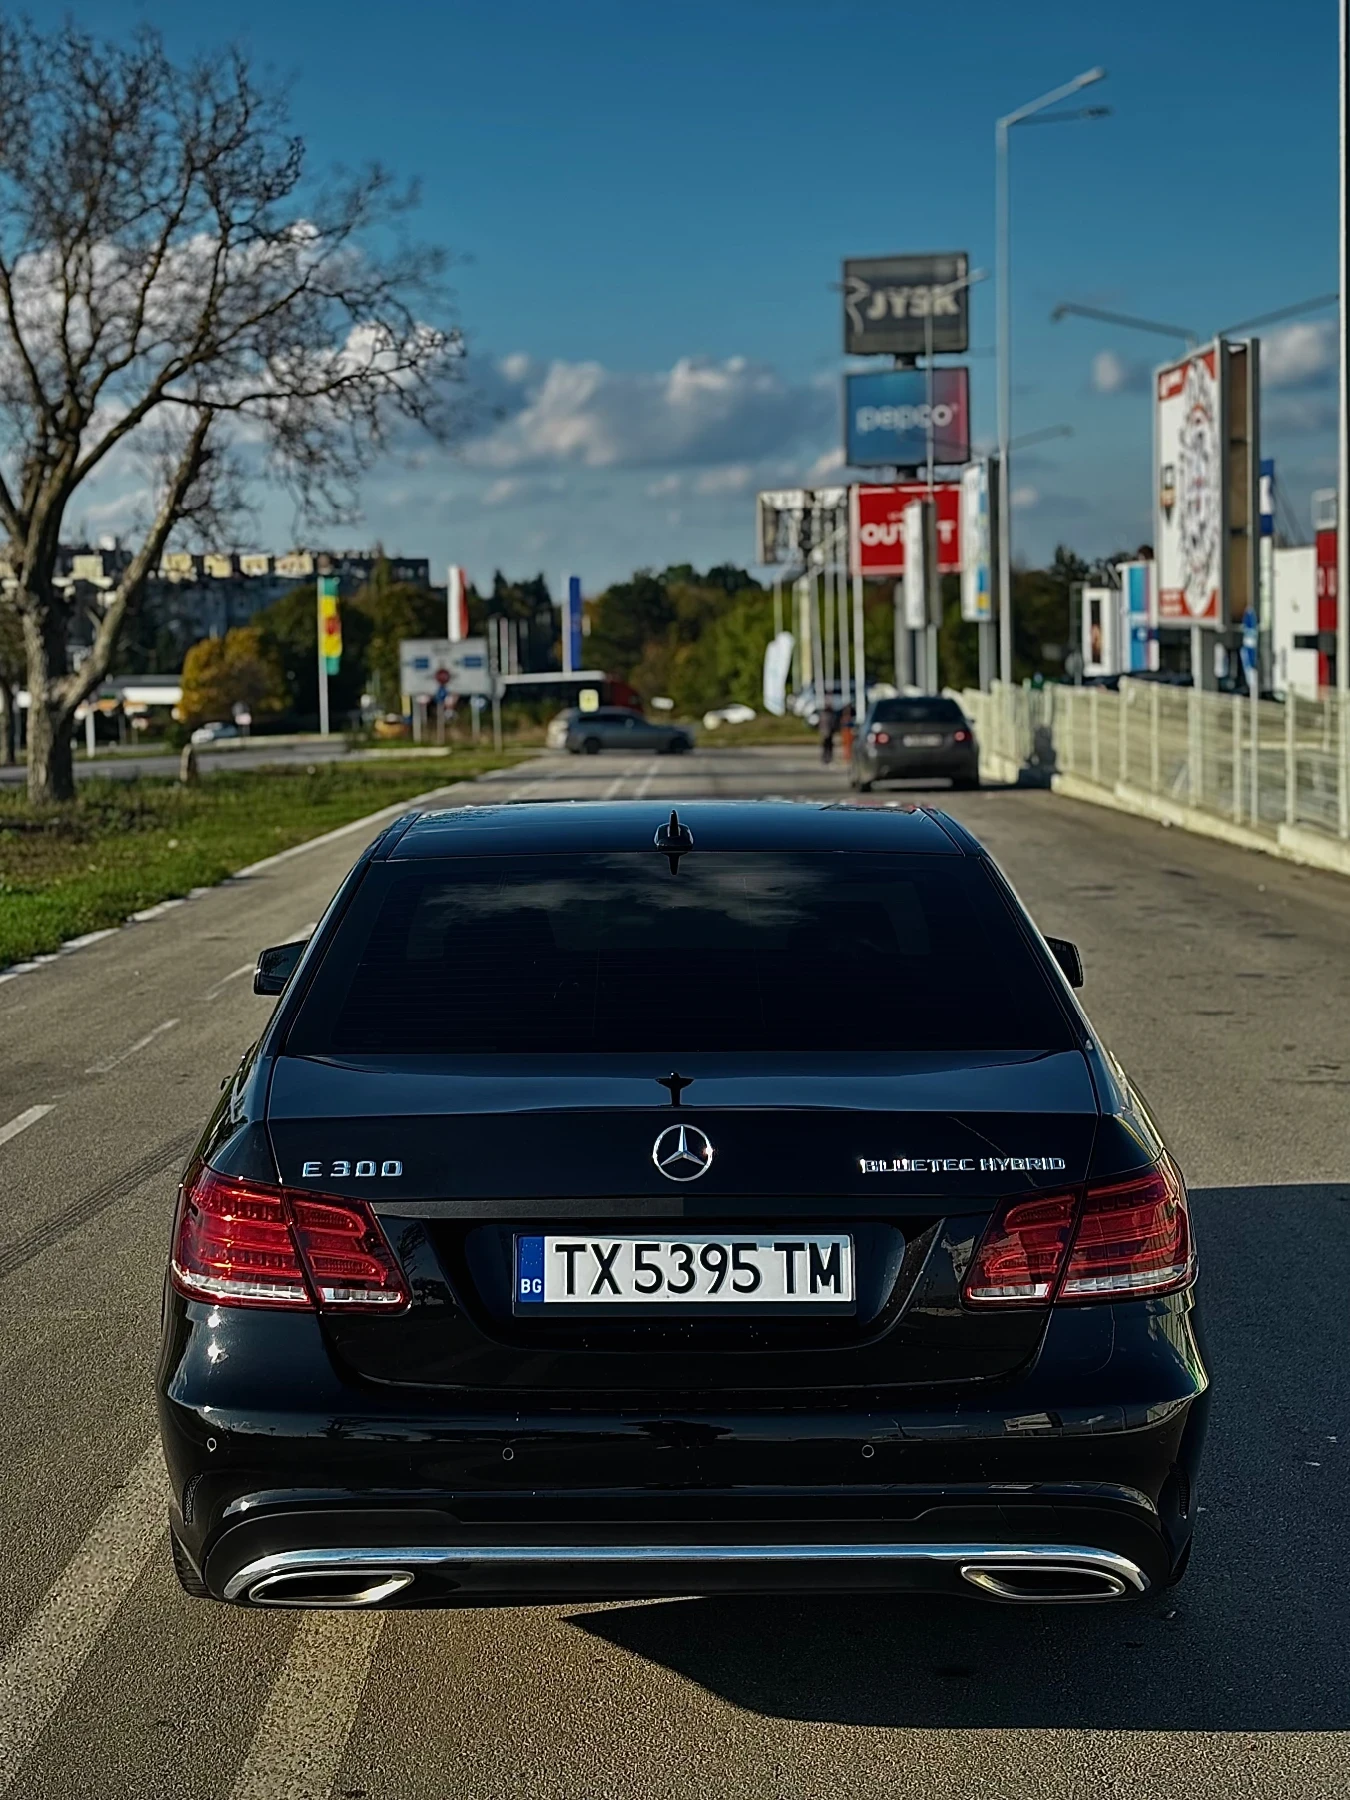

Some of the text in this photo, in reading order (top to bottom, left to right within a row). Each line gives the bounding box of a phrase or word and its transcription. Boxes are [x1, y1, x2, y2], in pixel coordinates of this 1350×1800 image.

[867, 285, 959, 319] JYSK
[856, 404, 953, 436] pepco
[302, 1160, 403, 1178] E 300
[859, 1157, 1066, 1173] BLUETEC HYBRID
[555, 1242, 843, 1295] TX 5395 TM
[521, 1278, 542, 1293] BG
